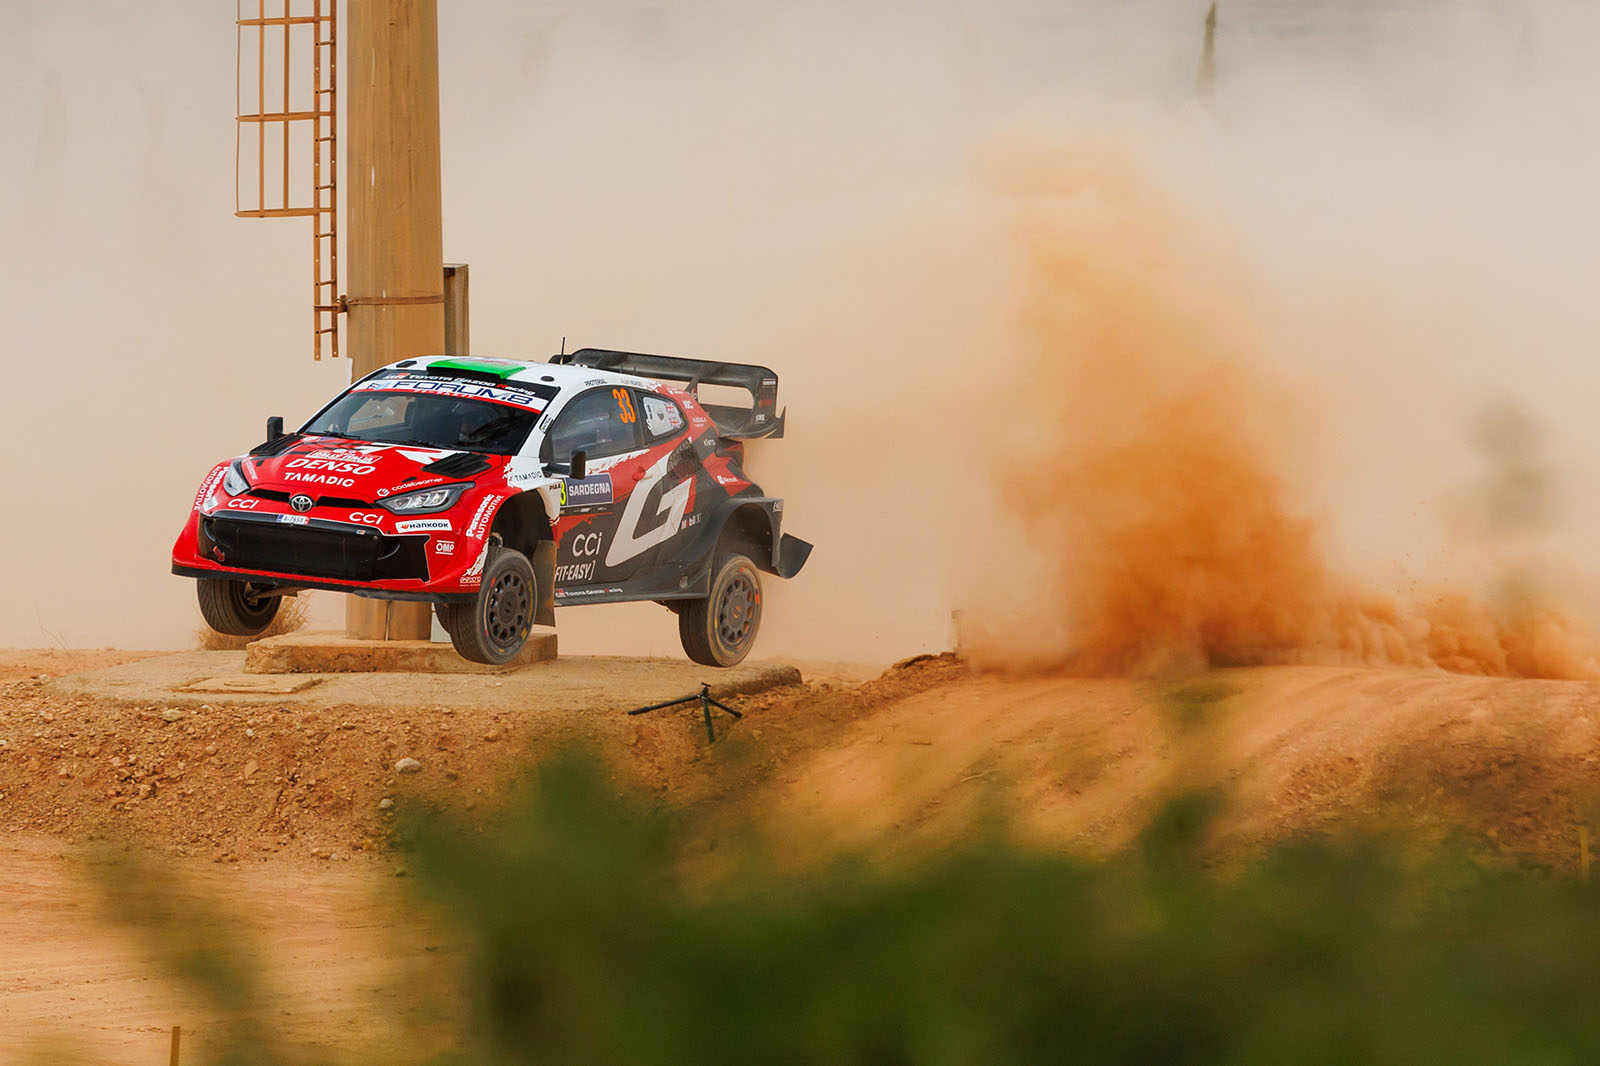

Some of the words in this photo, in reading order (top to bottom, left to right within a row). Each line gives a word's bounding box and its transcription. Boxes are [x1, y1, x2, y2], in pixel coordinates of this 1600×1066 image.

[408, 375, 453, 383] TOYOTA
[393, 381, 534, 405] FORUM8
[612, 388, 636, 423] 33
[285, 458, 377, 475] DENSO
[284, 472, 355, 487] TAMADIC
[515, 470, 543, 481] TAMADIC
[569, 482, 611, 497] SARDEGNA
[228, 498, 260, 509] CCI
[349, 512, 383, 525] CCI
[465, 494, 495, 538] Panasonic
[475, 495, 504, 541] AUTOMOTIVE
[435, 542, 455, 553] OMP
